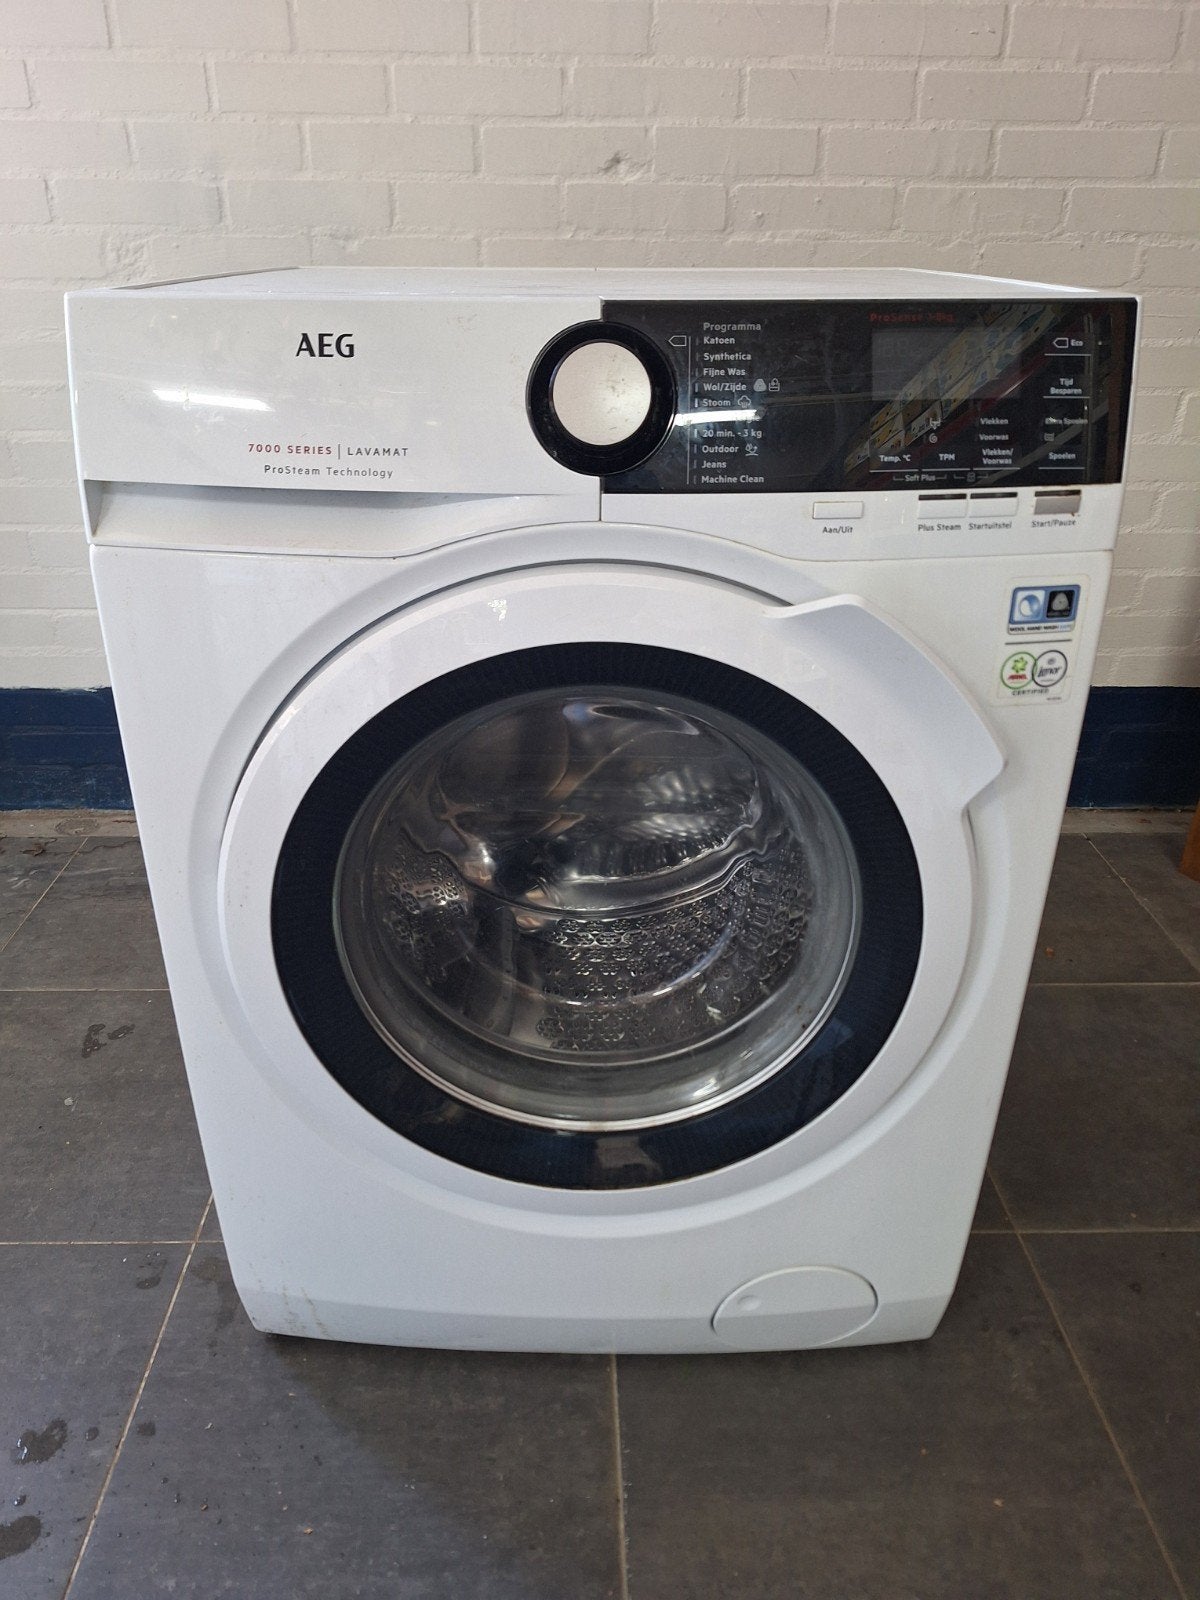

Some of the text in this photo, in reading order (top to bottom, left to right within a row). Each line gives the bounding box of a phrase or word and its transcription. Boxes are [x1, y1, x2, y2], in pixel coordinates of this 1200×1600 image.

[703, 322, 762, 333] Programma
[295, 332, 355, 358] AEG
[703, 336, 736, 345] Katoen
[703, 352, 752, 362] Synthetica
[703, 368, 746, 378] Fijne Was
[1059, 378, 1074, 387] Tijd
[703, 382, 747, 393] Wol/Zijde
[702, 398, 731, 407] Stoom
[980, 417, 1009, 425] Vlekken
[702, 429, 714, 438] 20
[716, 429, 735, 438] min.
[743, 429, 749, 437] 3
[751, 428, 762, 439] kg
[979, 433, 1009, 441] Voorwas
[248, 443, 409, 457] 7000 SERIES LAVAMAT
[702, 444, 739, 453] Outdoor
[939, 453, 955, 461] TPM
[982, 457, 1012, 465] Voorwas
[1048, 452, 1076, 461] Spoelen
[701, 460, 727, 469] Jeans
[264, 464, 393, 479] ProSteam Technology
[701, 475, 765, 484] Machine Clean
[905, 473, 936, 482] Soft Plus
[918, 523, 961, 532] Plus Steam
[968, 521, 1012, 531] Startuitstel
[1031, 519, 1077, 529] Start/Pauze
[822, 525, 853, 536] Aan/Uit
